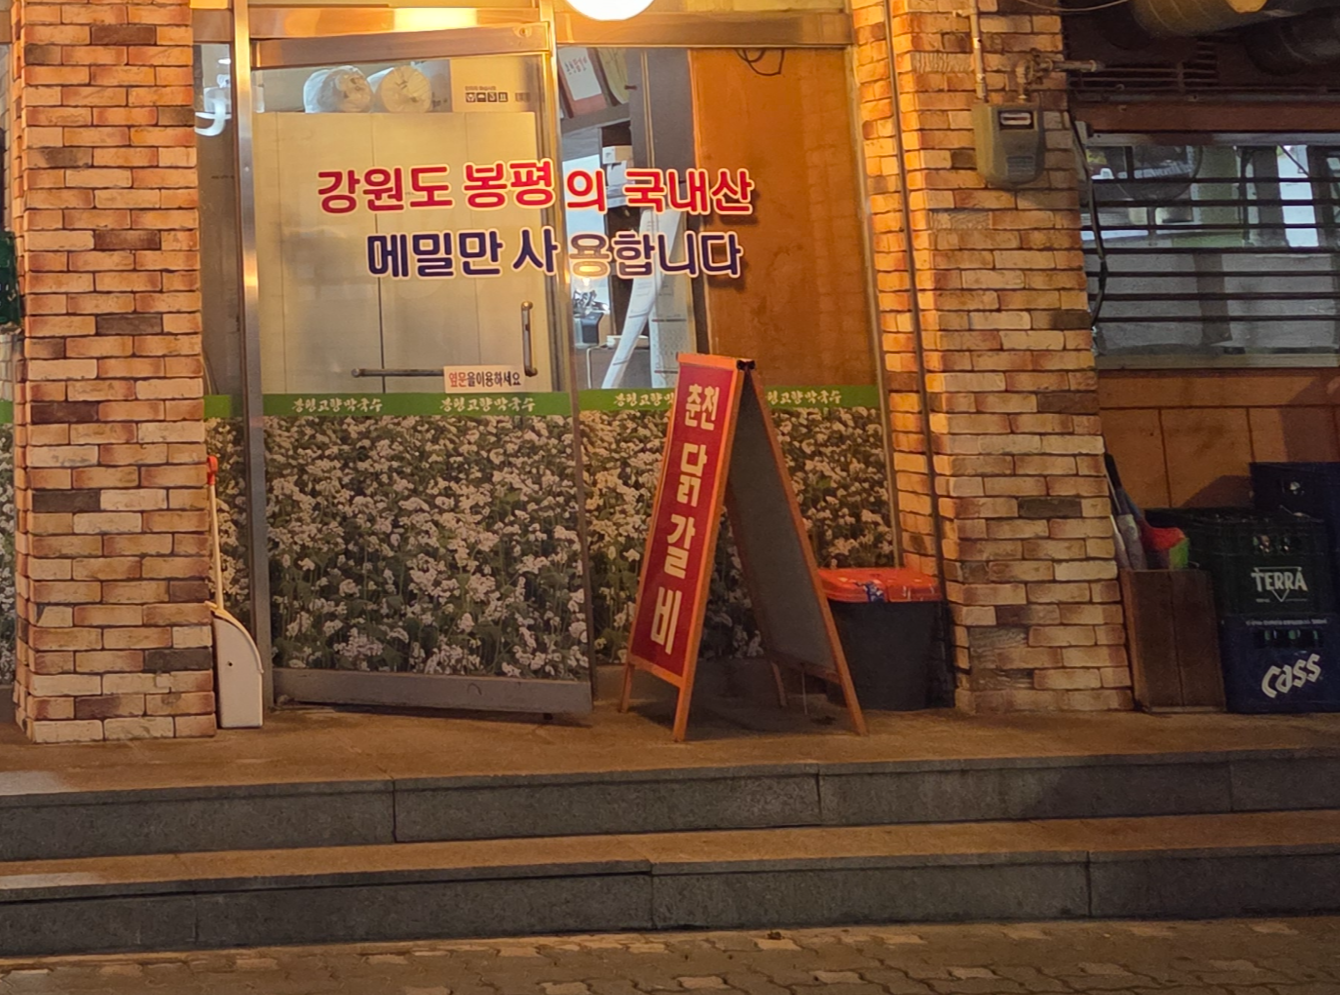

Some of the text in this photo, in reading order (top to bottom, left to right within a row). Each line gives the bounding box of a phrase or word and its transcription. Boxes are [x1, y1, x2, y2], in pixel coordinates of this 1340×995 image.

[317, 166, 454, 214] 강원도
[623, 168, 754, 215] 국내산
[366, 229, 504, 279] 메밀만
[684, 383, 721, 431] 춘천
[1251, 570, 1308, 592] TERRA
